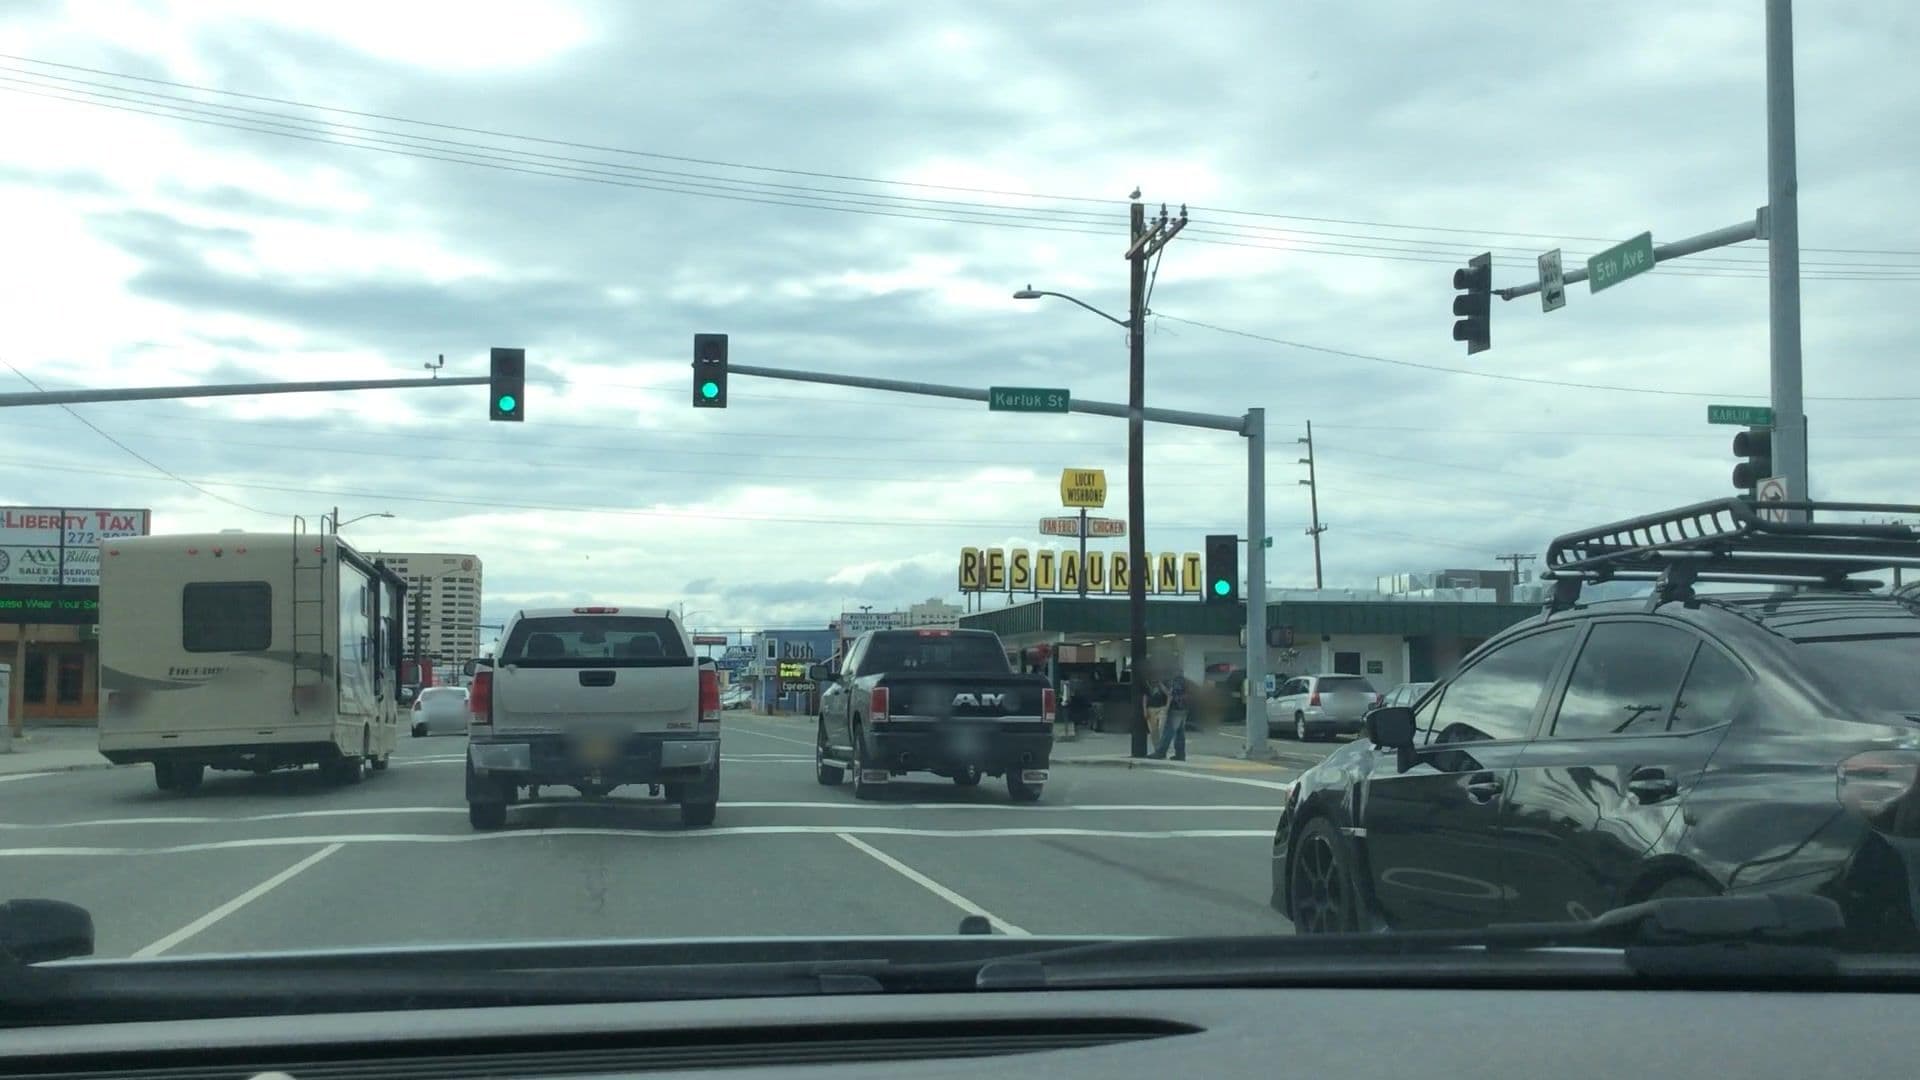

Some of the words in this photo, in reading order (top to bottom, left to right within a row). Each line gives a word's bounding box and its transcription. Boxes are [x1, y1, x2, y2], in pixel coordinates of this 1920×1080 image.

[1597, 261, 1618, 281] 5th
[1622, 249, 1645, 272] Ave
[1047, 394, 1064, 408] St
[1074, 472, 1096, 487] LUCKY
[1067, 488, 1103, 502] WISHBONE
[26, 599, 52, 609] Wear
[784, 641, 814, 659] Rush
